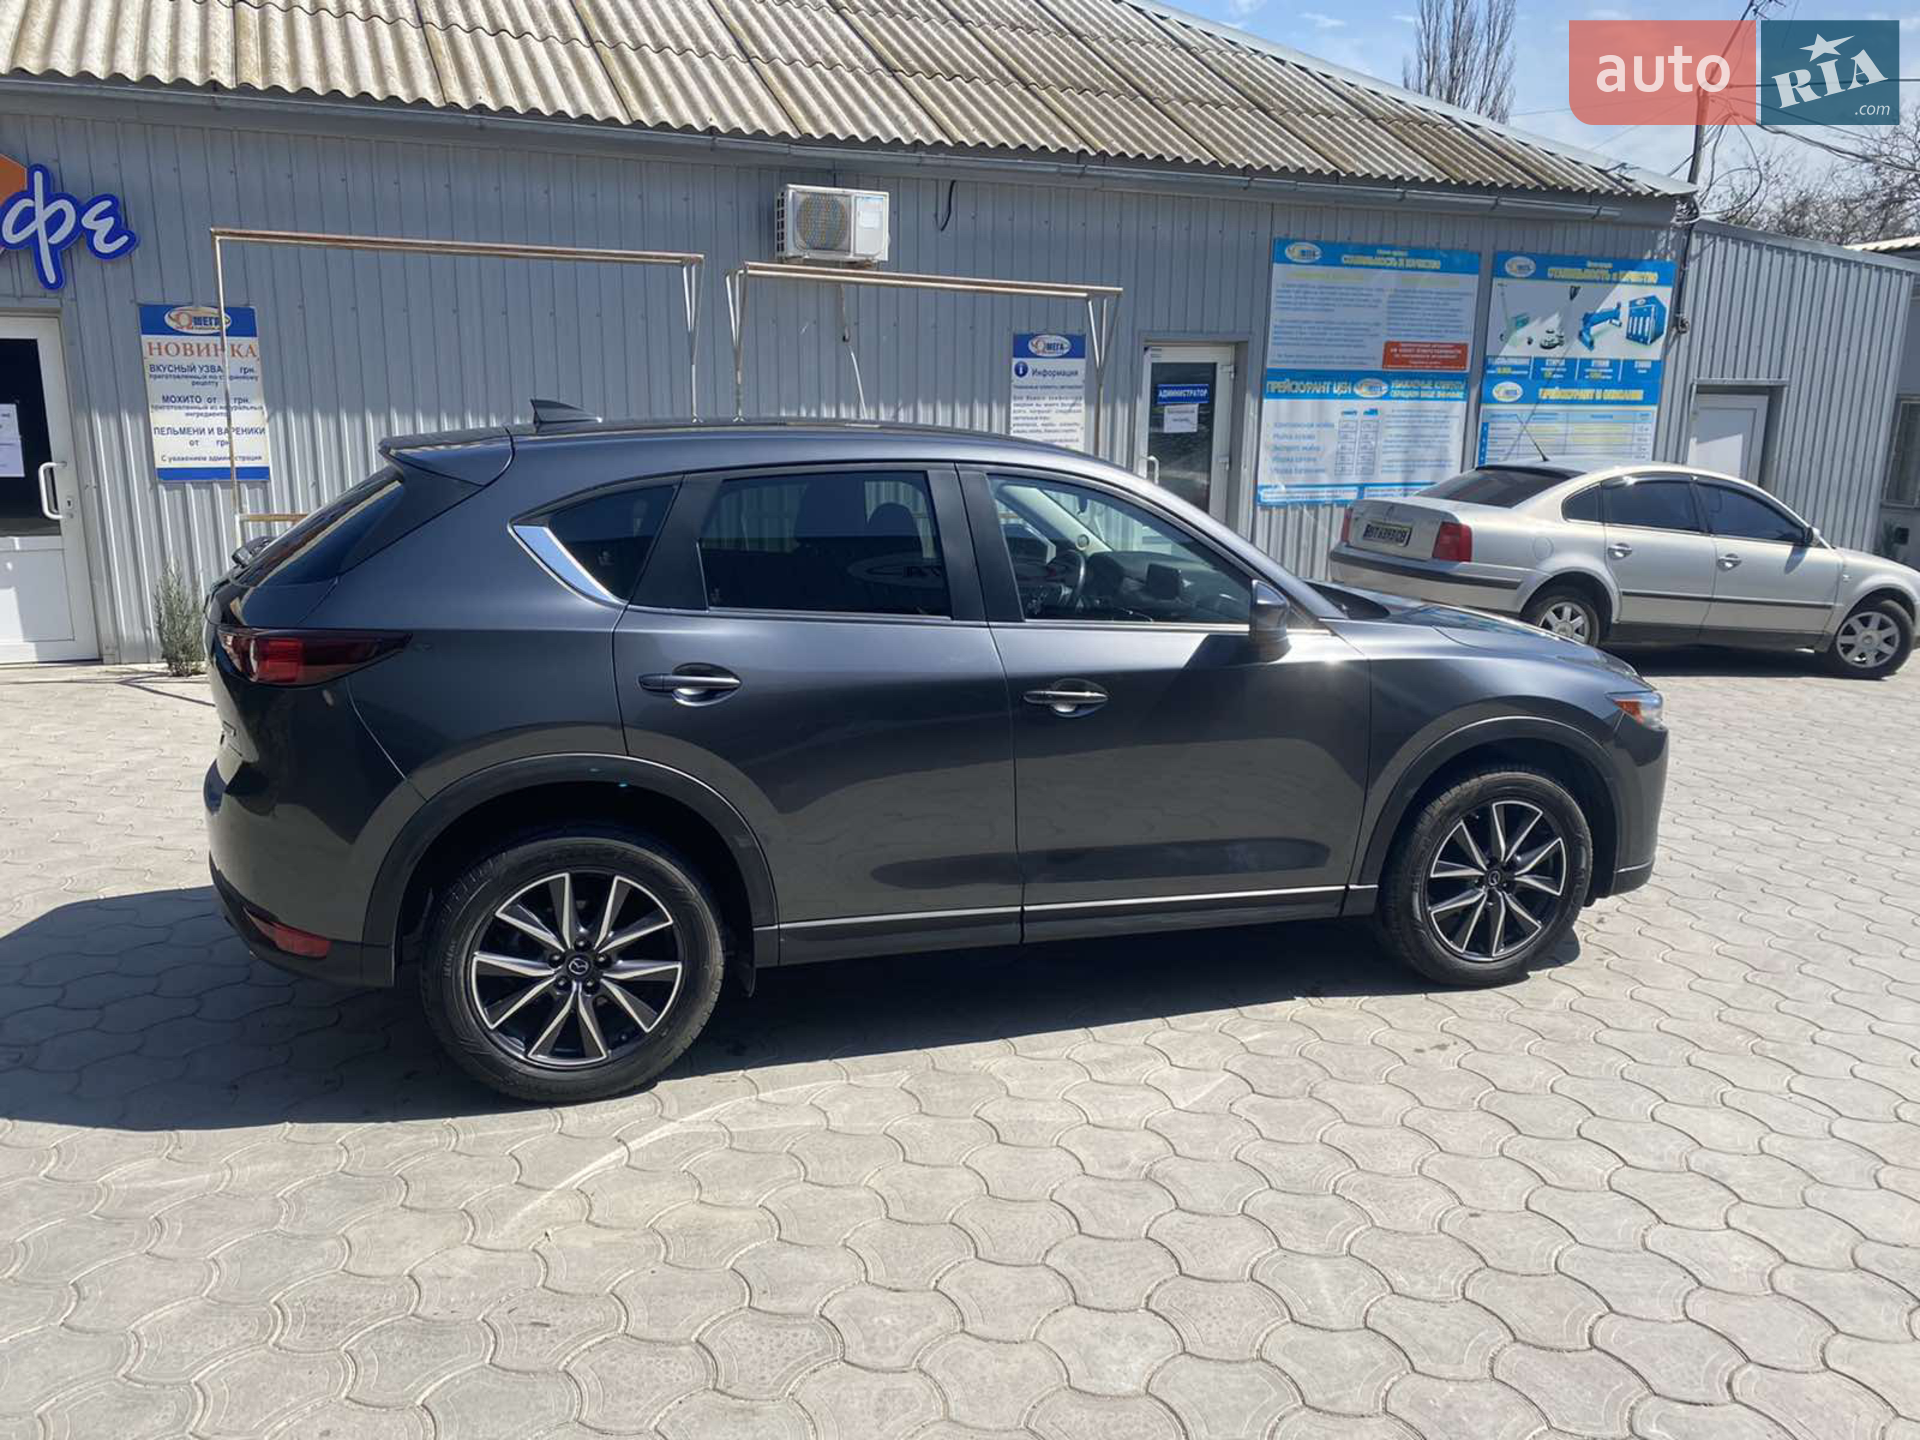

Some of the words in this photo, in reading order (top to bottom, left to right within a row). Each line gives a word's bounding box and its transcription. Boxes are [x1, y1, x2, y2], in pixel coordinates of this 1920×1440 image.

[147, 341, 257, 358] НОВИНКА
[149, 363, 197, 374] ВКУСНЫЙ
[1031, 366, 1079, 379] Информация
[162, 394, 202, 404] МОХИТО
[206, 396, 216, 404] от
[153, 426, 206, 436] ПЕЛЬМЕНИ
[208, 427, 215, 436] И
[160, 454, 168, 462] С
